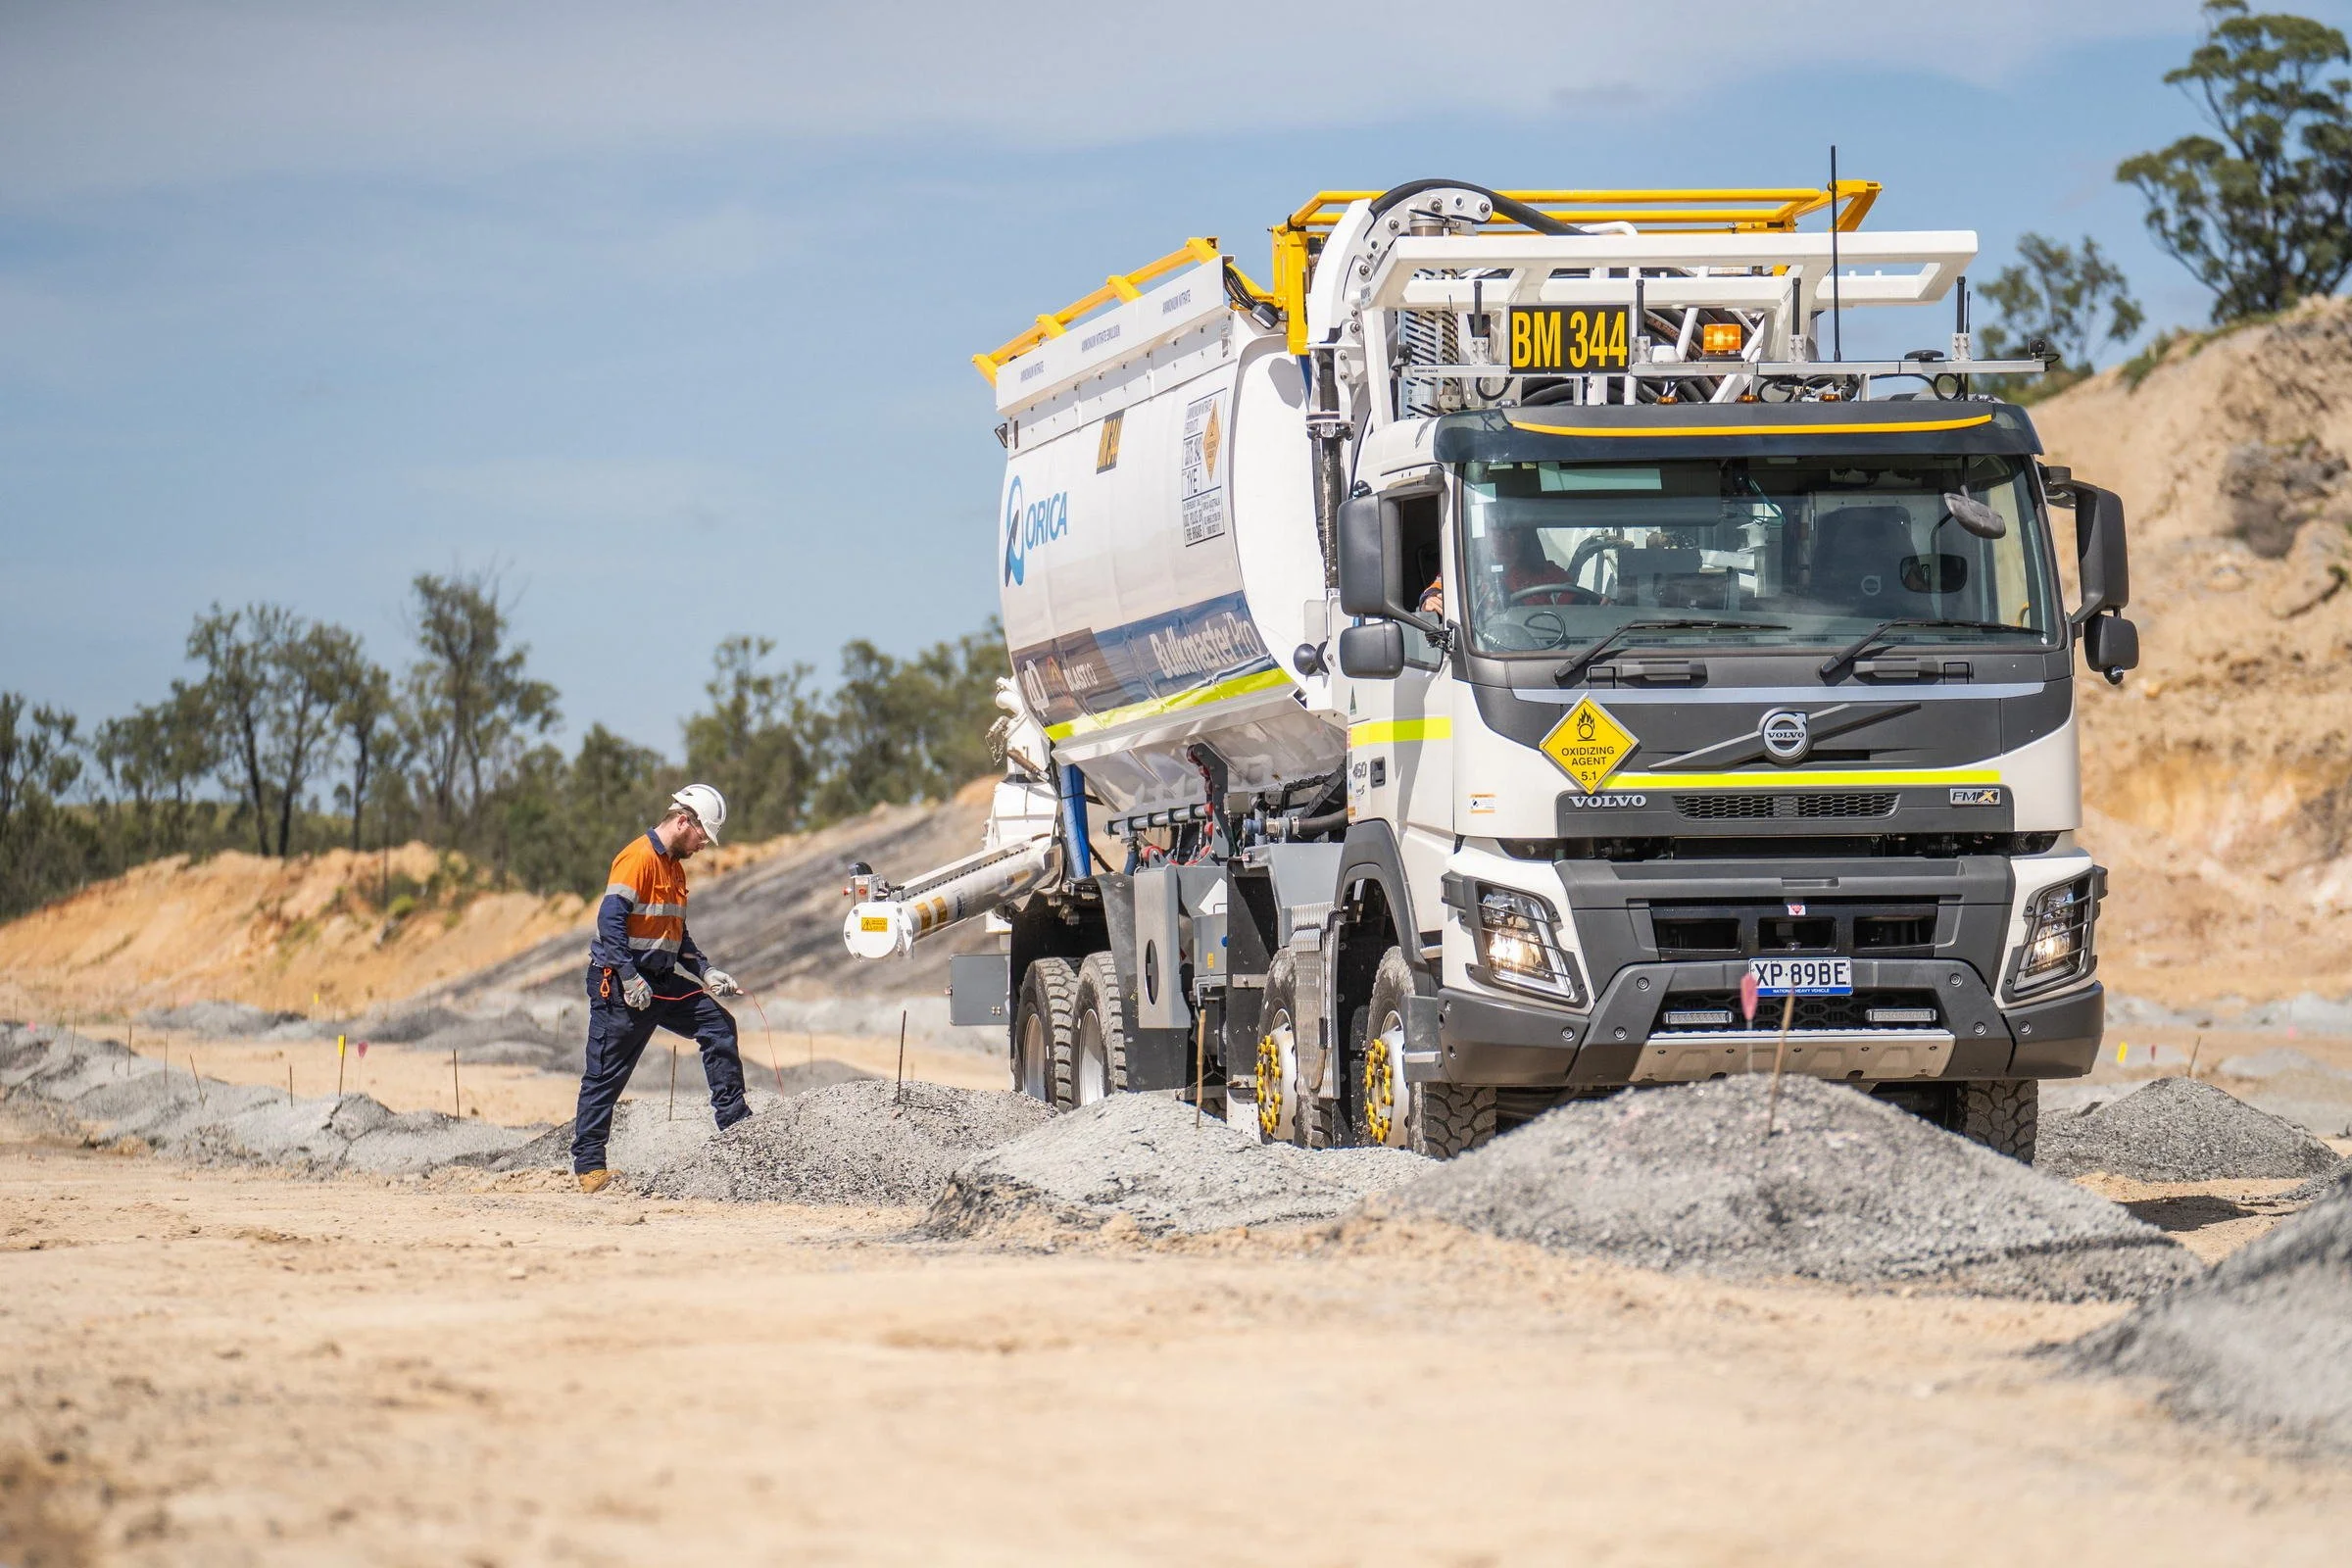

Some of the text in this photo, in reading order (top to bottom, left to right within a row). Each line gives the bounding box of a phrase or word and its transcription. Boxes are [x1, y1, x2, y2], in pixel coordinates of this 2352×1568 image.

[1512, 311, 1561, 368] BM
[1570, 310, 1628, 368] 344
[1026, 491, 1067, 551] ORICA
[1150, 612, 1262, 679] Bulkmaster Pro
[1561, 746, 1615, 757] OXIDIZING
[1571, 757, 1607, 766] AGENT
[1581, 771, 1597, 781] 5.1
[1568, 795, 1647, 808] VOLVO
[1952, 789, 1999, 804] FMX
